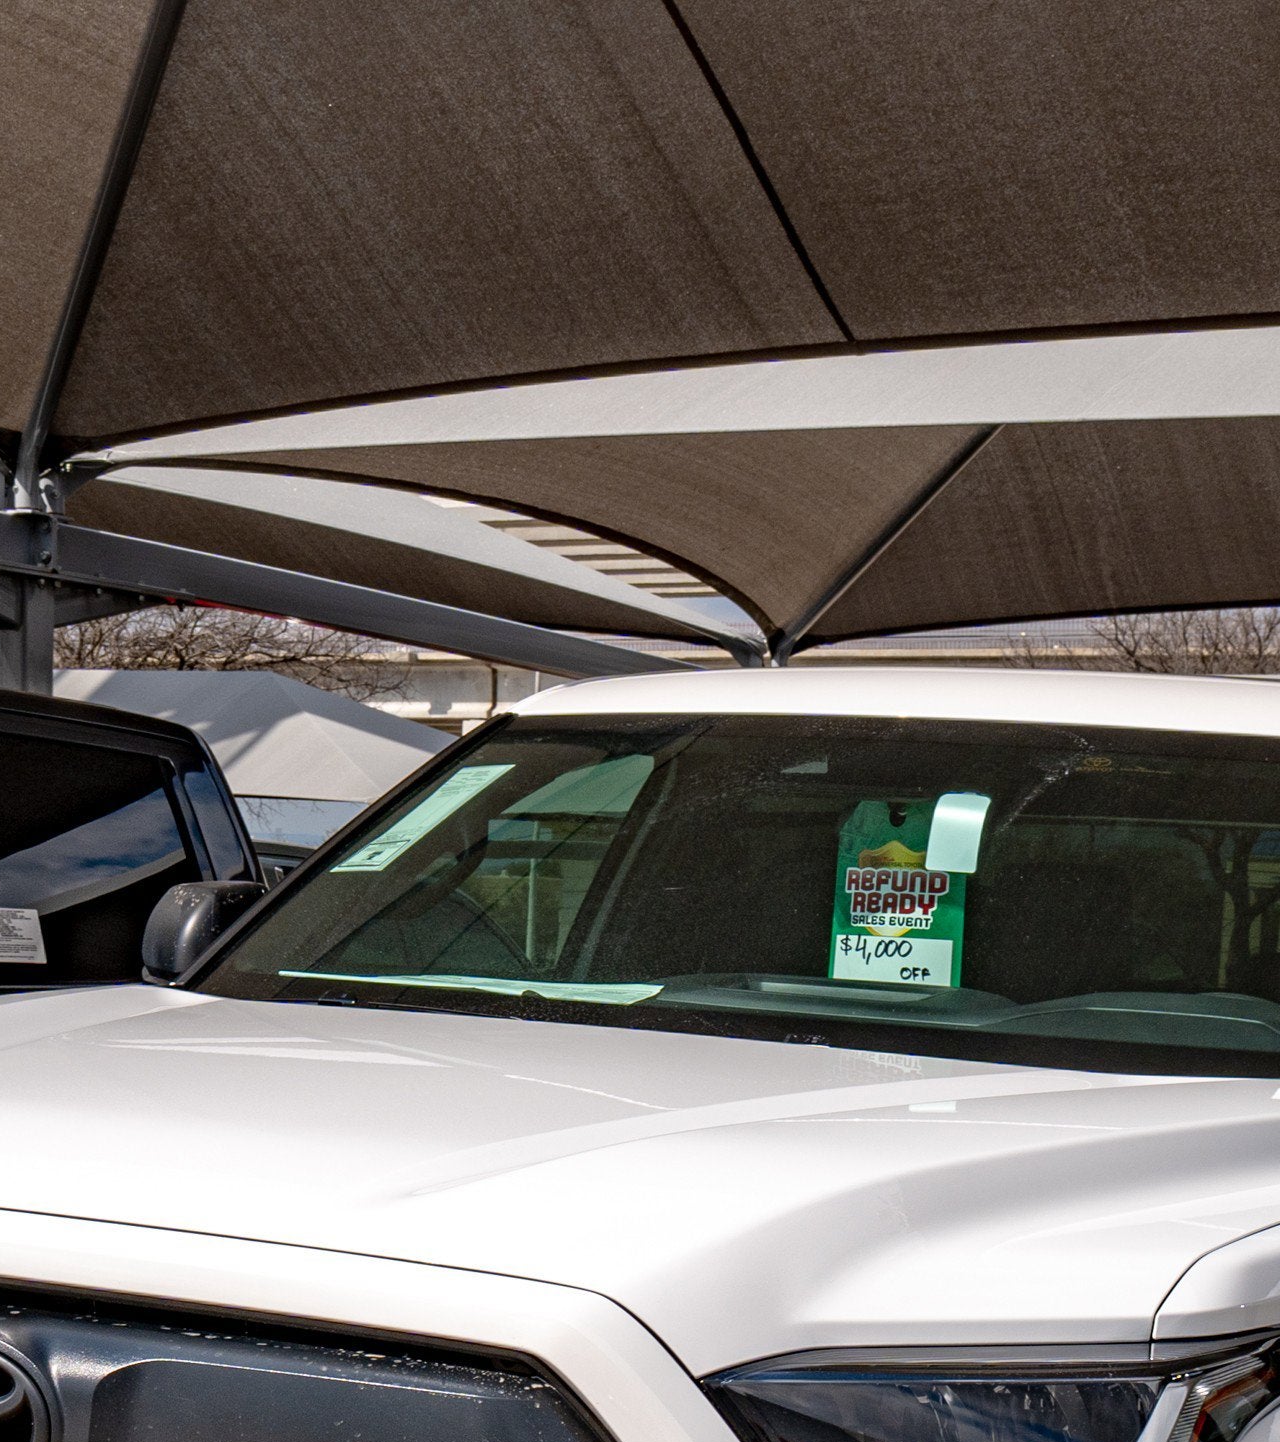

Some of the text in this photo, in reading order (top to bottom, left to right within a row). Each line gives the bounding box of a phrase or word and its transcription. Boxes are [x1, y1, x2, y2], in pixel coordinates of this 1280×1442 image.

[847, 870, 948, 893] REFUND
[852, 892, 936, 916] READY
[851, 914, 932, 928] SALES EVENT
[840, 936, 913, 965] $4,000
[900, 967, 932, 981] OFF
